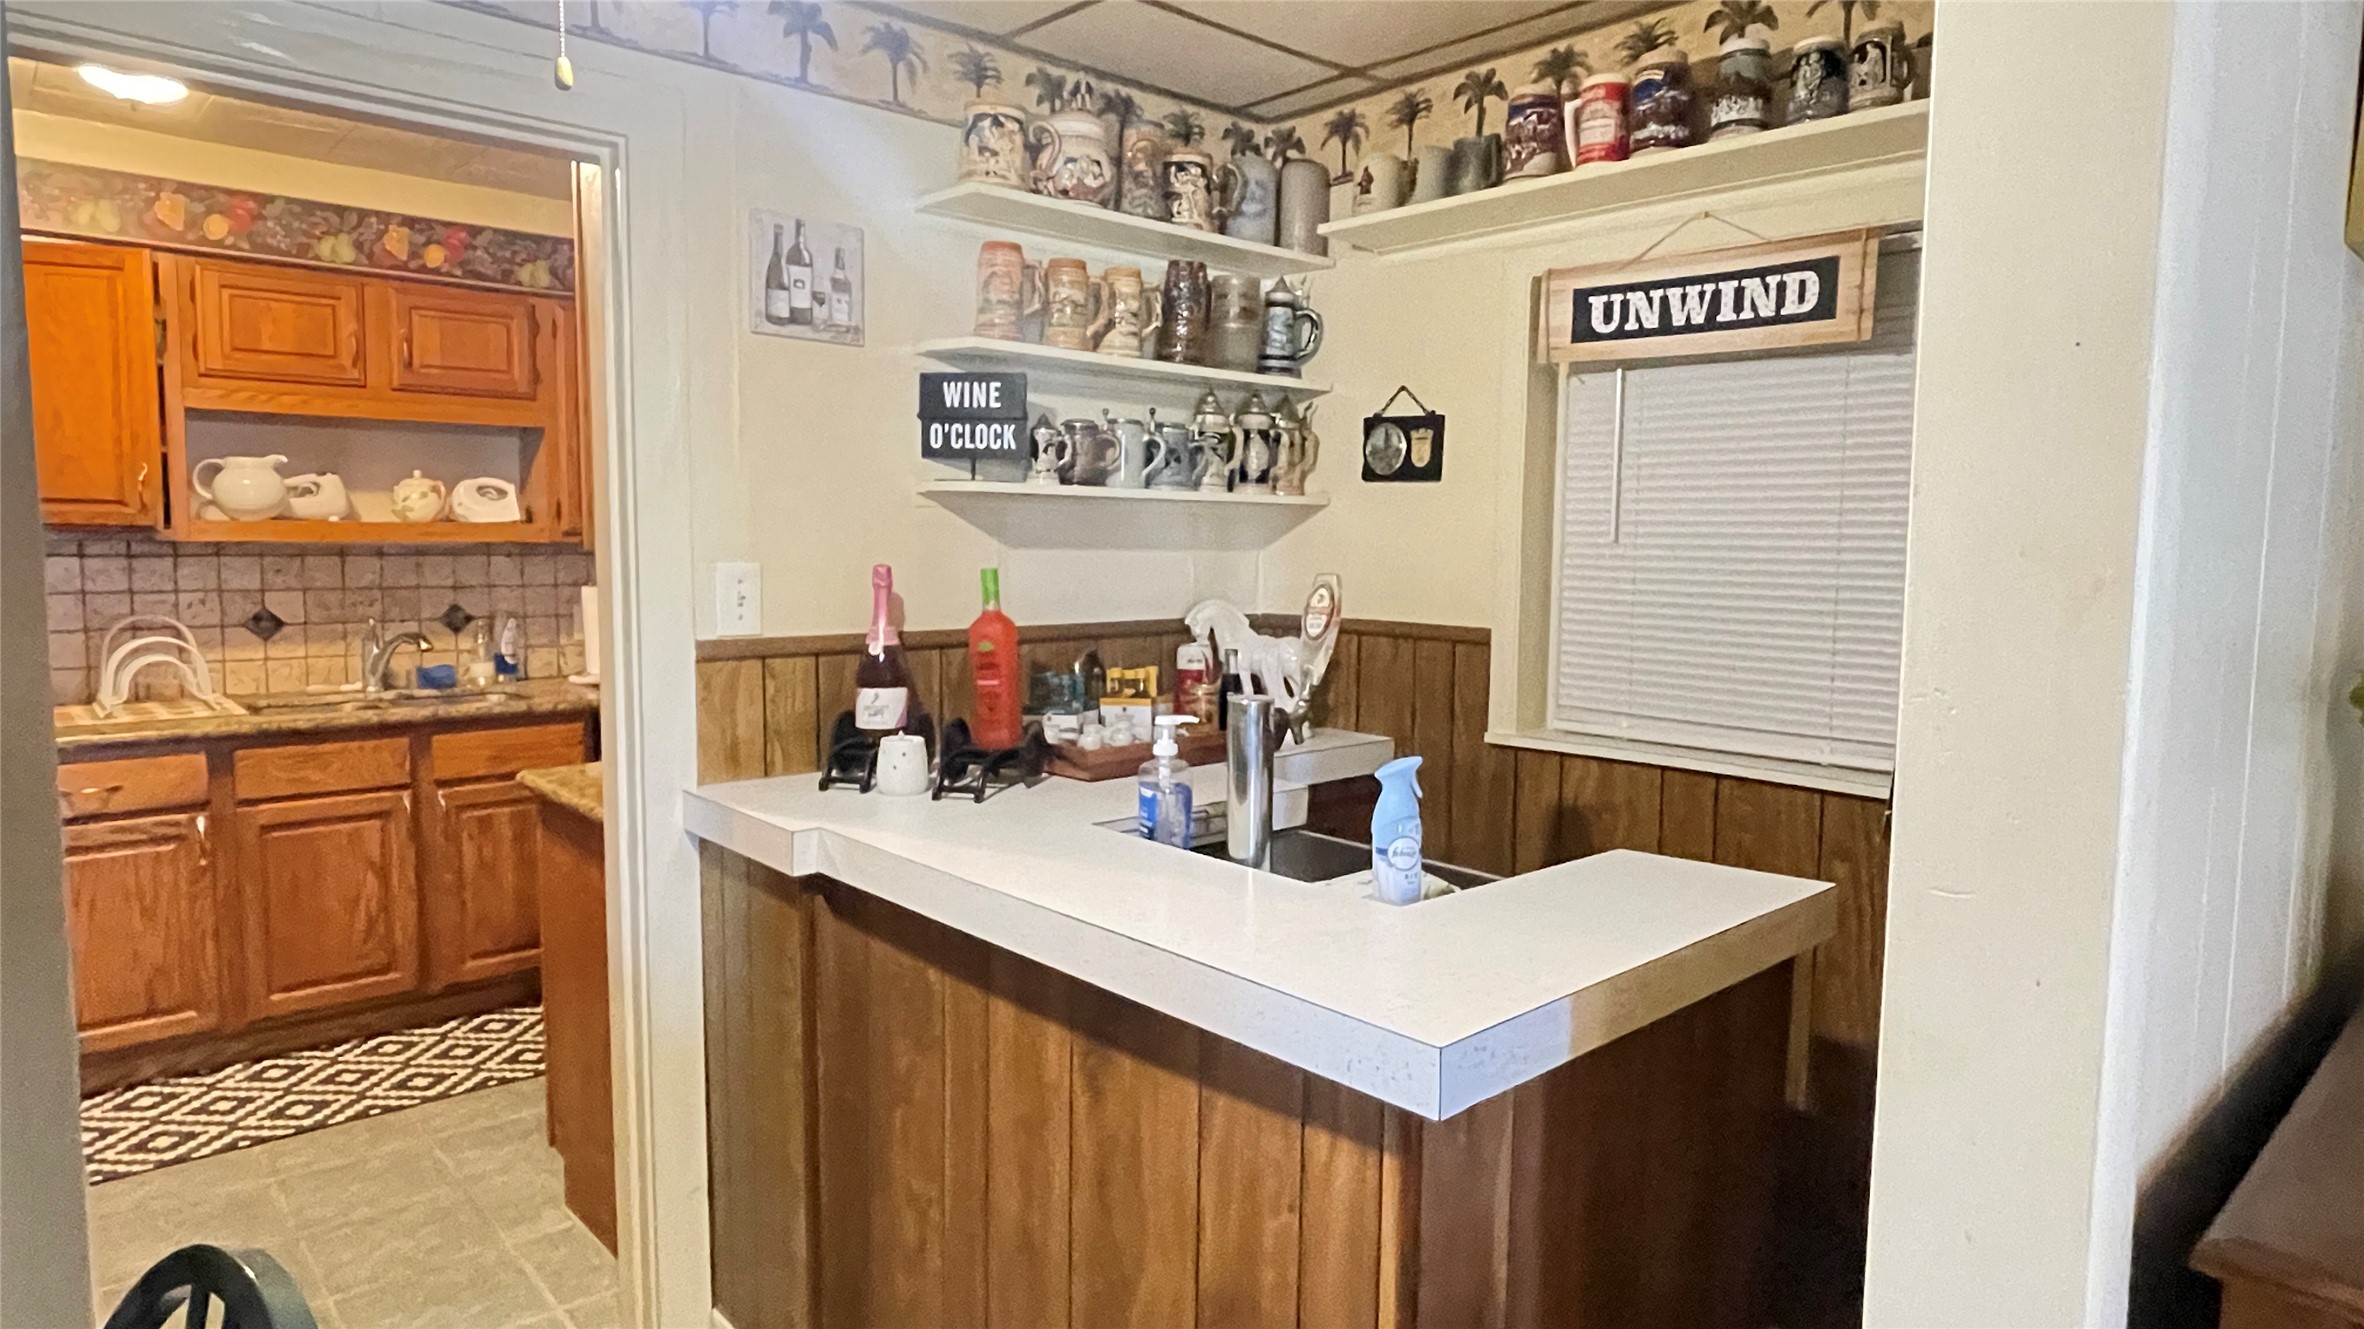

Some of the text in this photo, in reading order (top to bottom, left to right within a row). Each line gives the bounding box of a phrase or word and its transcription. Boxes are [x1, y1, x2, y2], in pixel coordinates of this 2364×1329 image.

[1587, 270, 1820, 334] UNWIND
[942, 381, 1002, 409] WINE
[929, 422, 1017, 450] O'CLOCK
